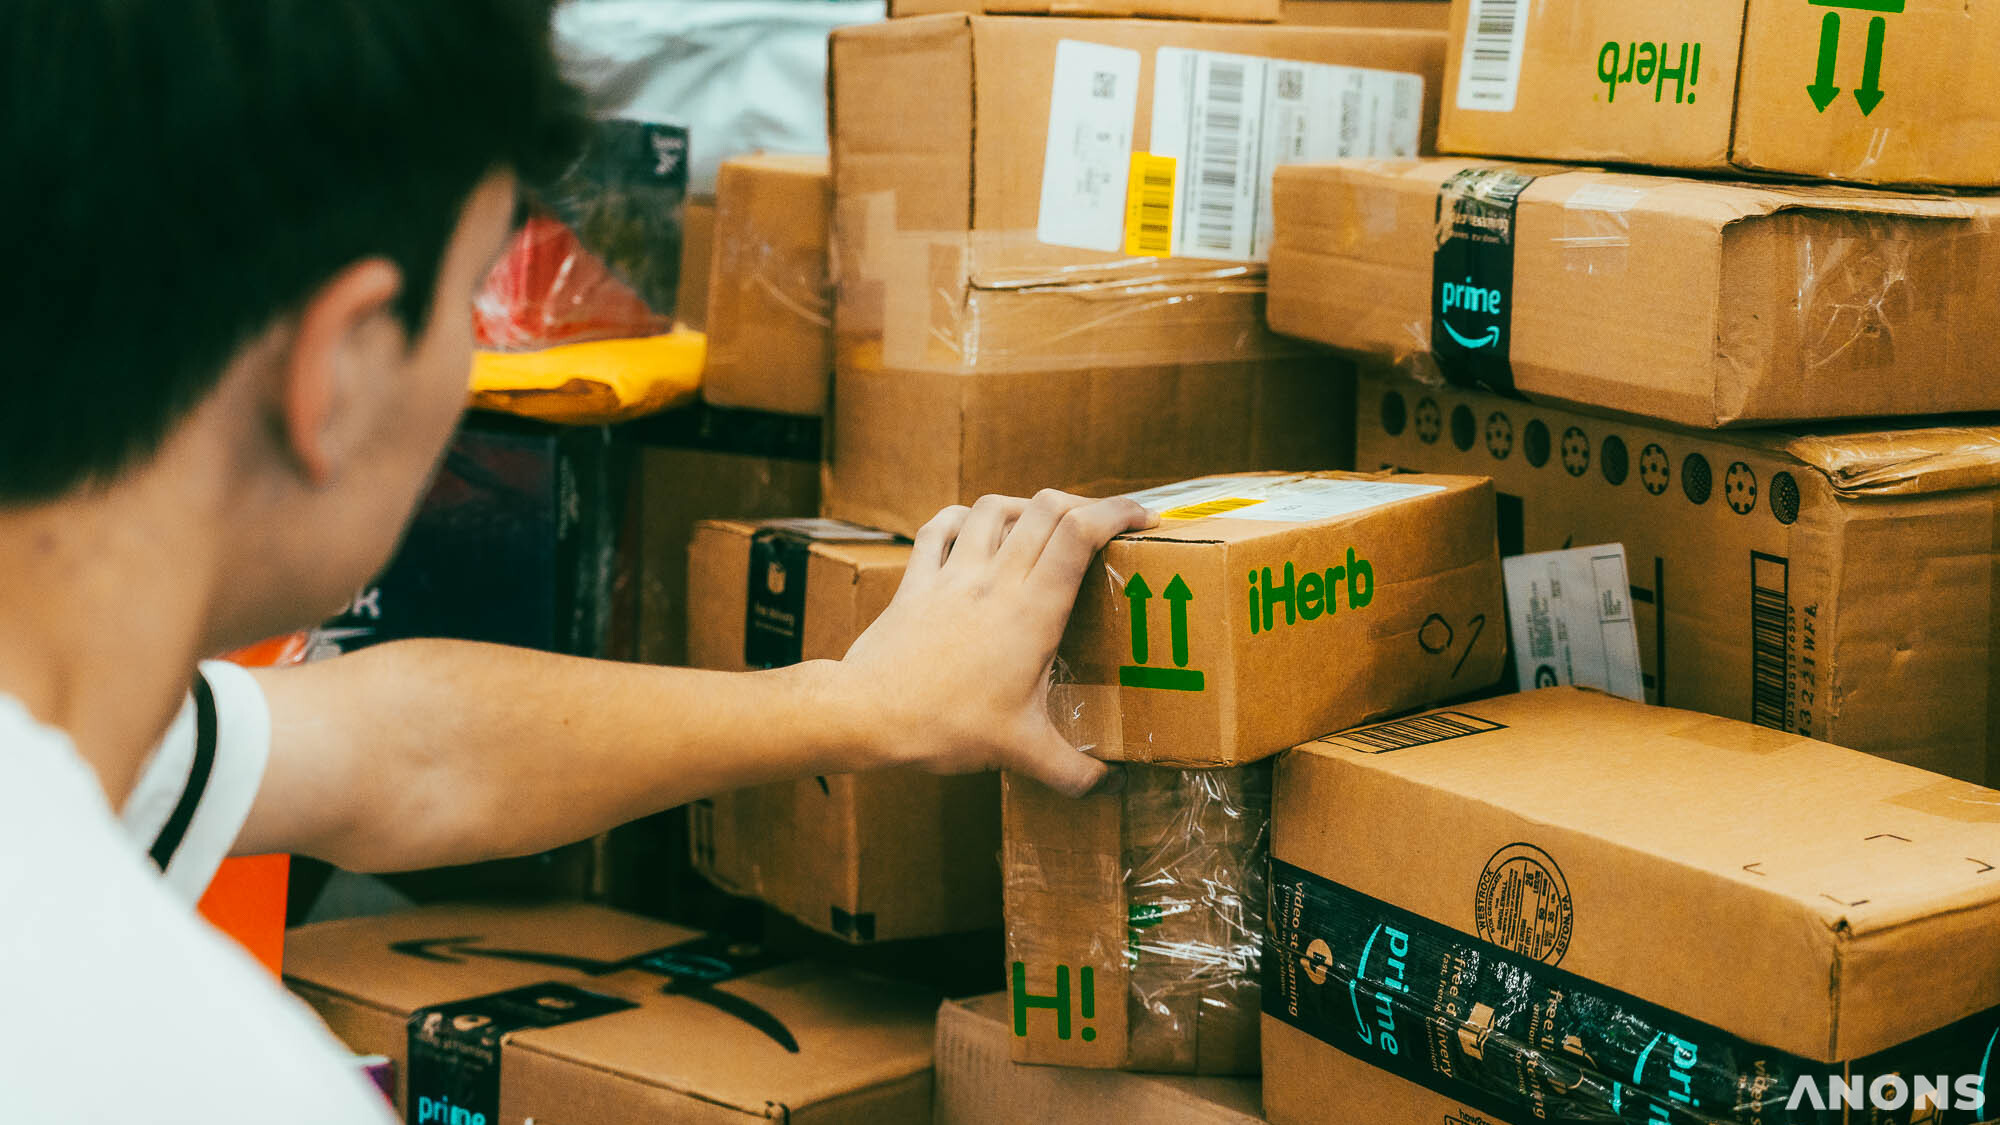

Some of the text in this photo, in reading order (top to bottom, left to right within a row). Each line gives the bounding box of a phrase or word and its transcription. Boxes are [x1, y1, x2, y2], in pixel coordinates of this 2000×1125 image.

[1597, 41, 1702, 105] iHerb
[1441, 275, 1502, 315] prime
[1248, 547, 1375, 635] iHerb
[1291, 881, 1305, 929] video
[1477, 866, 1494, 931] WESTROCK
[1561, 894, 1570, 911] PA
[1012, 961, 1097, 1043] H!
[1374, 925, 1410, 1057] prime
[1449, 957, 1467, 996] free
[418, 1095, 486, 1125] prime
[1648, 1033, 1701, 1125] pri
